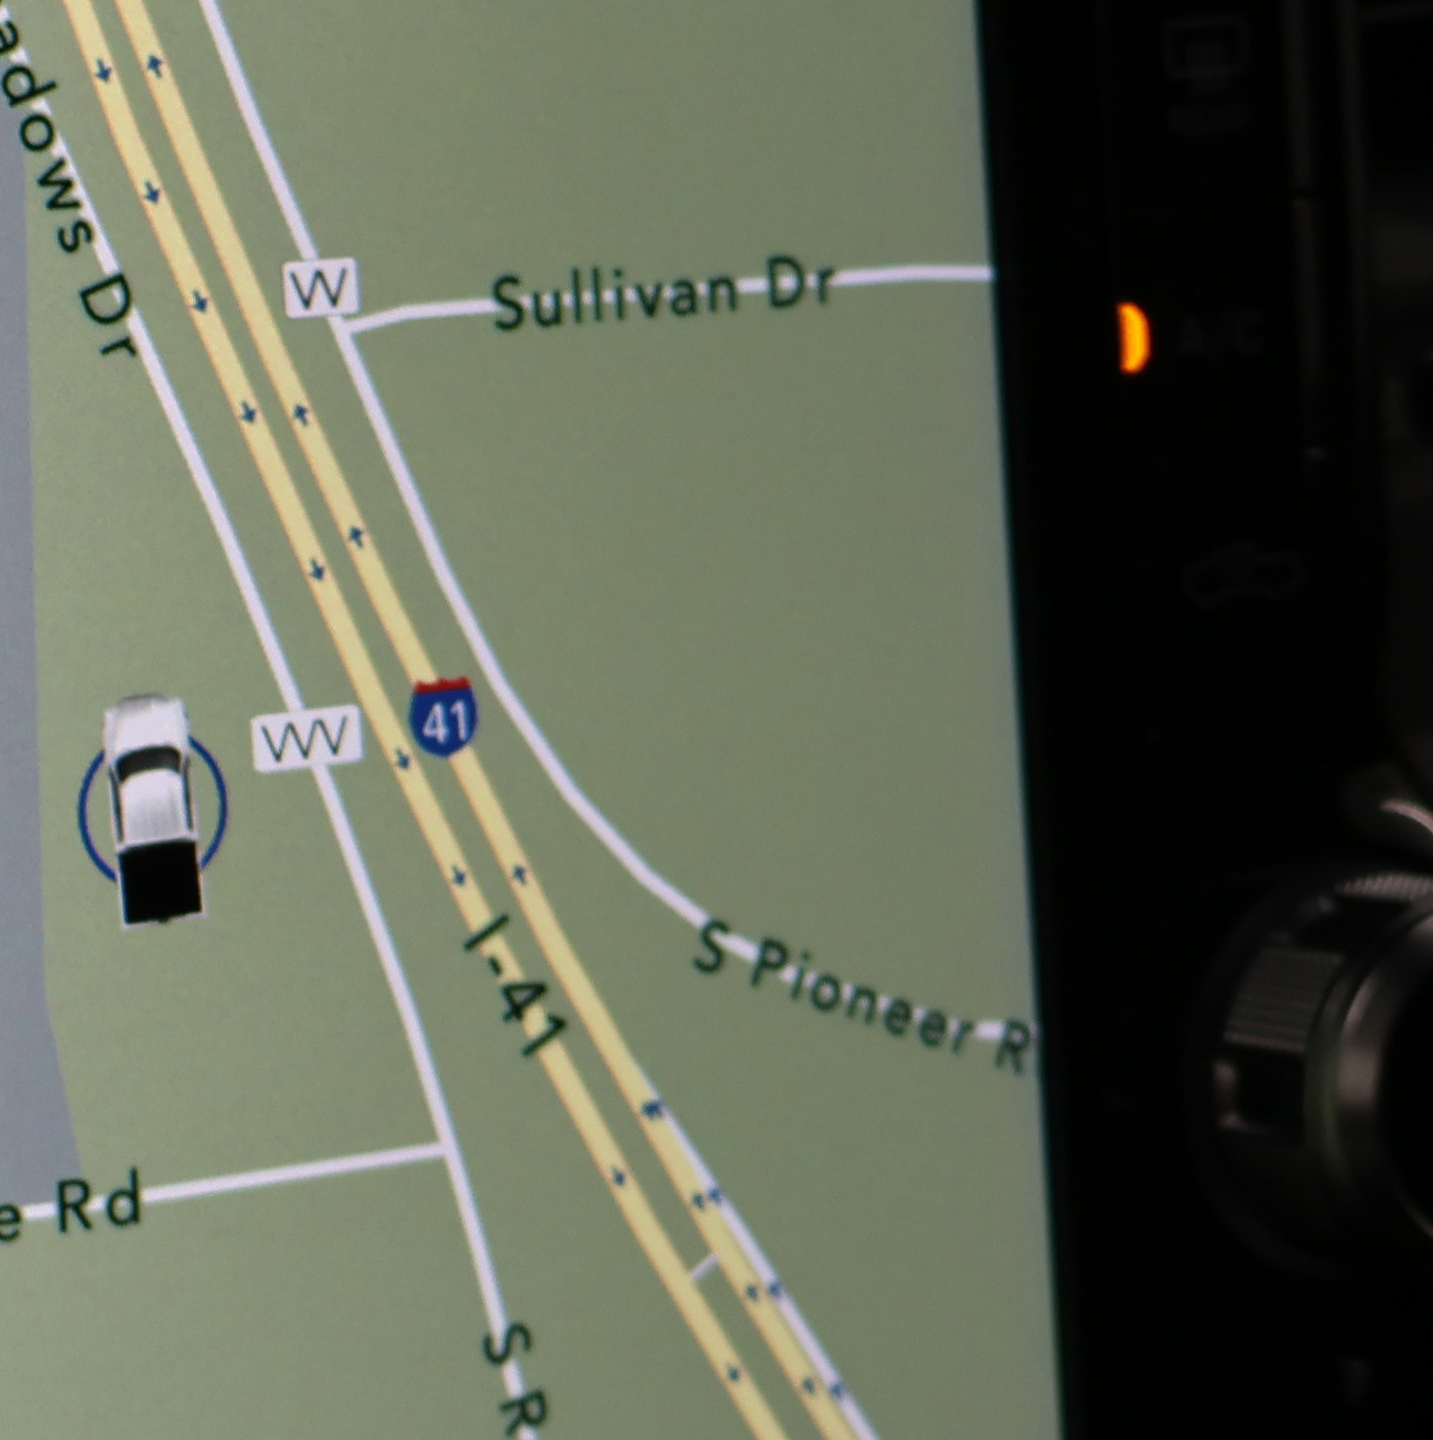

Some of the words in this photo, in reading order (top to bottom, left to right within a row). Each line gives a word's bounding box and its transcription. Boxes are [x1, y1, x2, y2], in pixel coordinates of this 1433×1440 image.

[79, 273, 136, 356] Dr
[492, 267, 738, 332] Sullivan
[766, 255, 833, 310] Dr
[421, 699, 469, 744] 41
[463, 914, 567, 1057] I-41
[693, 920, 729, 975] S
[751, 937, 973, 1054] Pioneer
[57, 1168, 140, 1233] Rd
[482, 1323, 532, 1366] S
